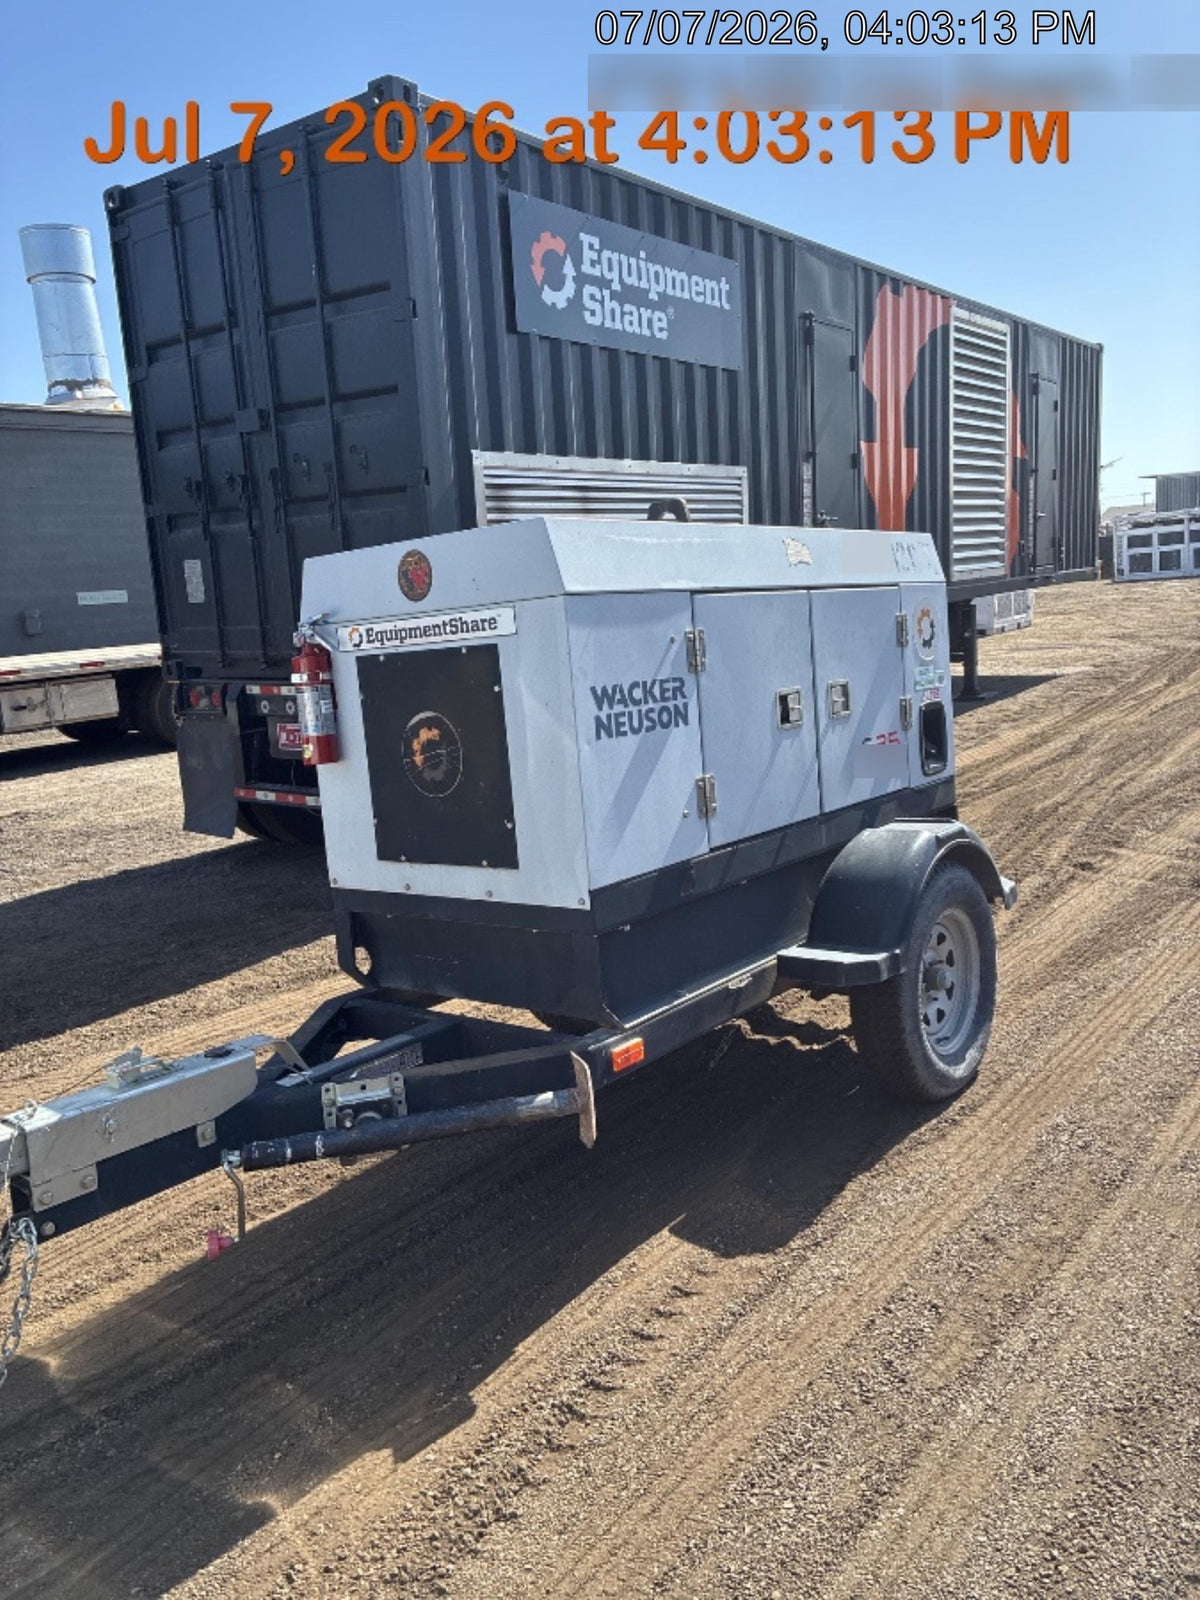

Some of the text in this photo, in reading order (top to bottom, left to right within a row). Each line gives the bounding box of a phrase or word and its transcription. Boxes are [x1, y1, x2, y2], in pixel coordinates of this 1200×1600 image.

[579, 232, 731, 310] Equipment
[365, 616, 498, 646] EquipmentShare
[589, 677, 688, 712] WACKER
[593, 702, 689, 741] NEUSON
